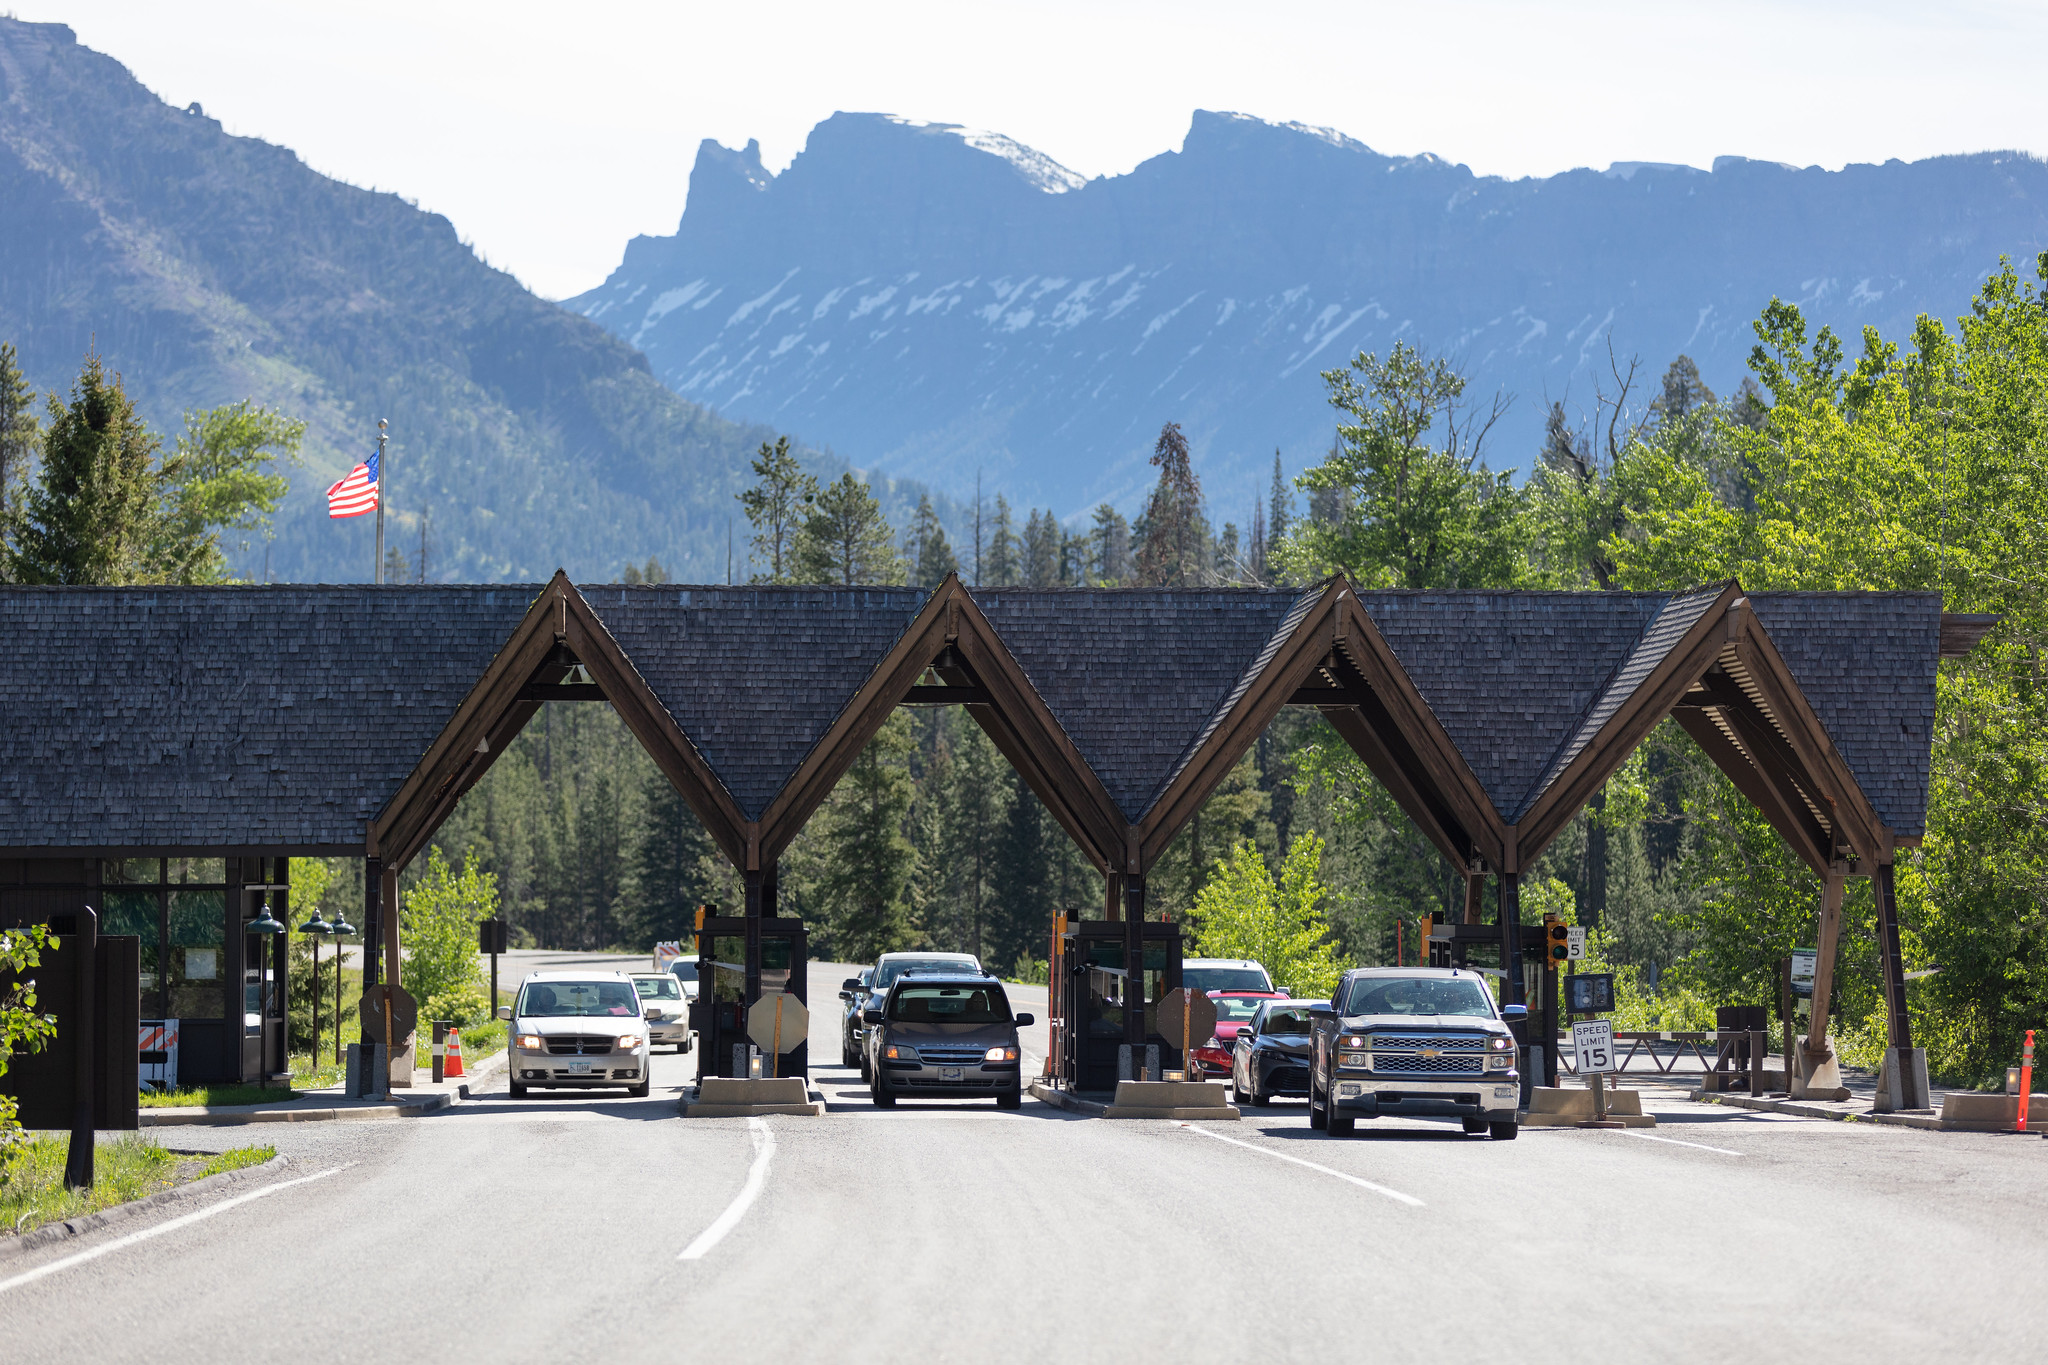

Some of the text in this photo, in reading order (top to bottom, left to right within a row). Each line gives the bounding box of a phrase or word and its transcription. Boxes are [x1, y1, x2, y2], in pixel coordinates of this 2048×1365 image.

[1570, 944, 1580, 956] 5
[1576, 1025, 1609, 1036] SPEED
[1580, 1036, 1606, 1047] LIMIT
[1582, 1048, 1608, 1068] 15
